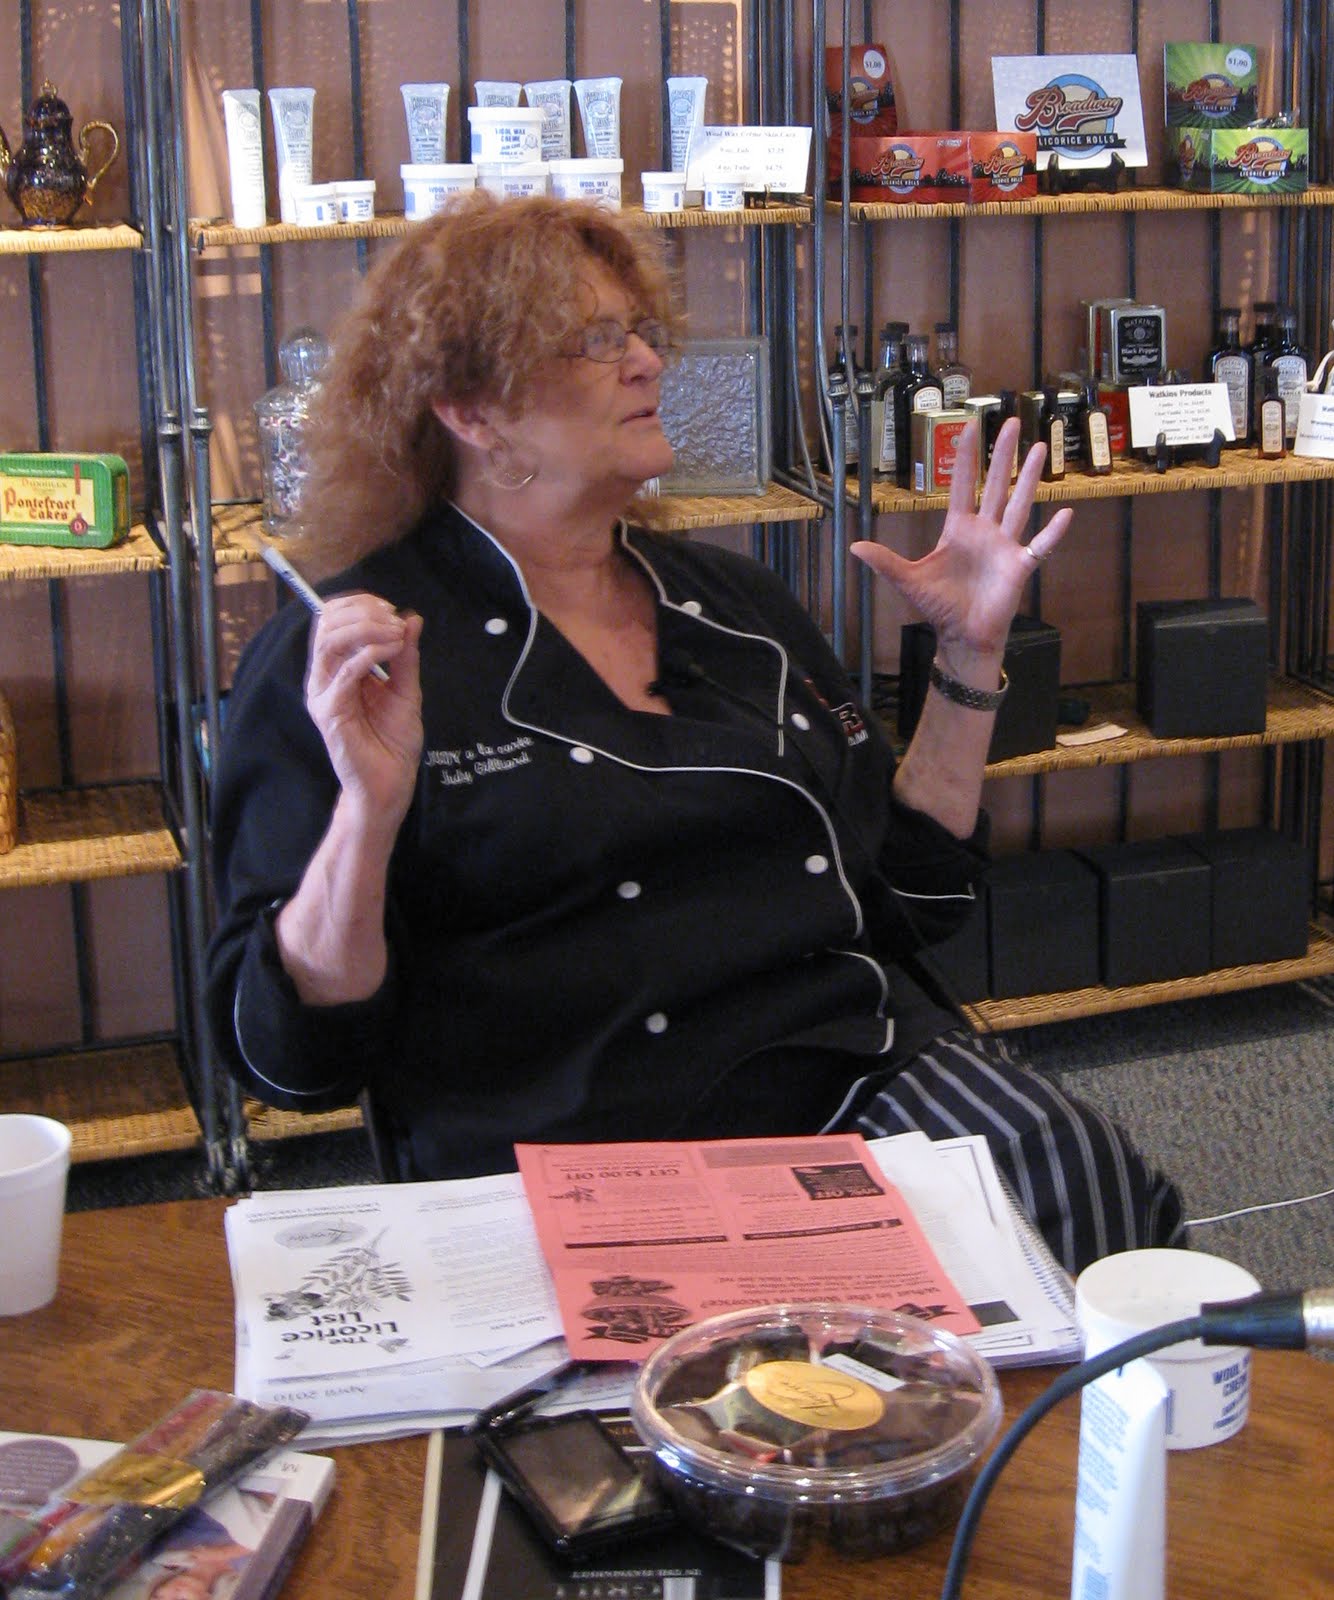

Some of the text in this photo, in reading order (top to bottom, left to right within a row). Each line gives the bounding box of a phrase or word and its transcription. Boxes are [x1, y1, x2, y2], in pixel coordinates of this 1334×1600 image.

[1015, 85, 1123, 132] Broadway
[1038, 134, 1115, 146] LICORICE ROLLS
[1180, 388, 1212, 396] Products
[4, 486, 76, 514] Pontefract
[310, 1312, 362, 1326] List
[281, 1322, 398, 1342] Licorice
[1212, 1363, 1240, 1386] WOOL
